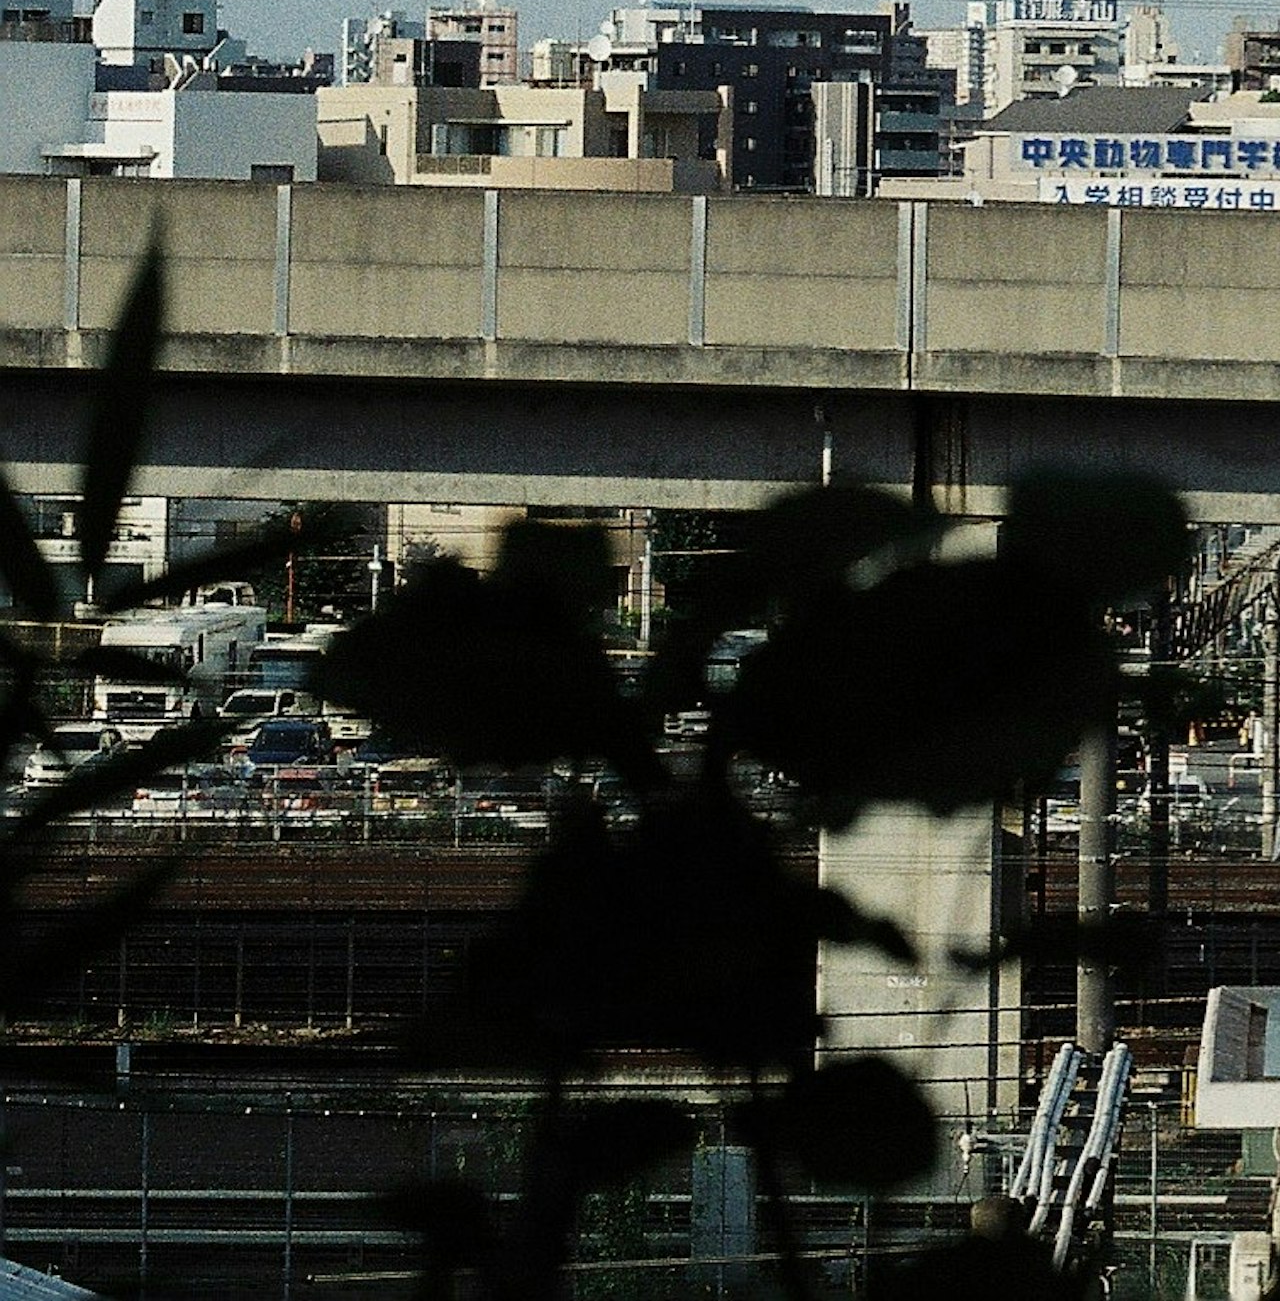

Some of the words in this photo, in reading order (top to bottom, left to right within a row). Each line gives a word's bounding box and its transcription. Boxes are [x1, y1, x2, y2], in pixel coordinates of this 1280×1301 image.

[1054, 185, 1275, 210] 入学相談受付中
